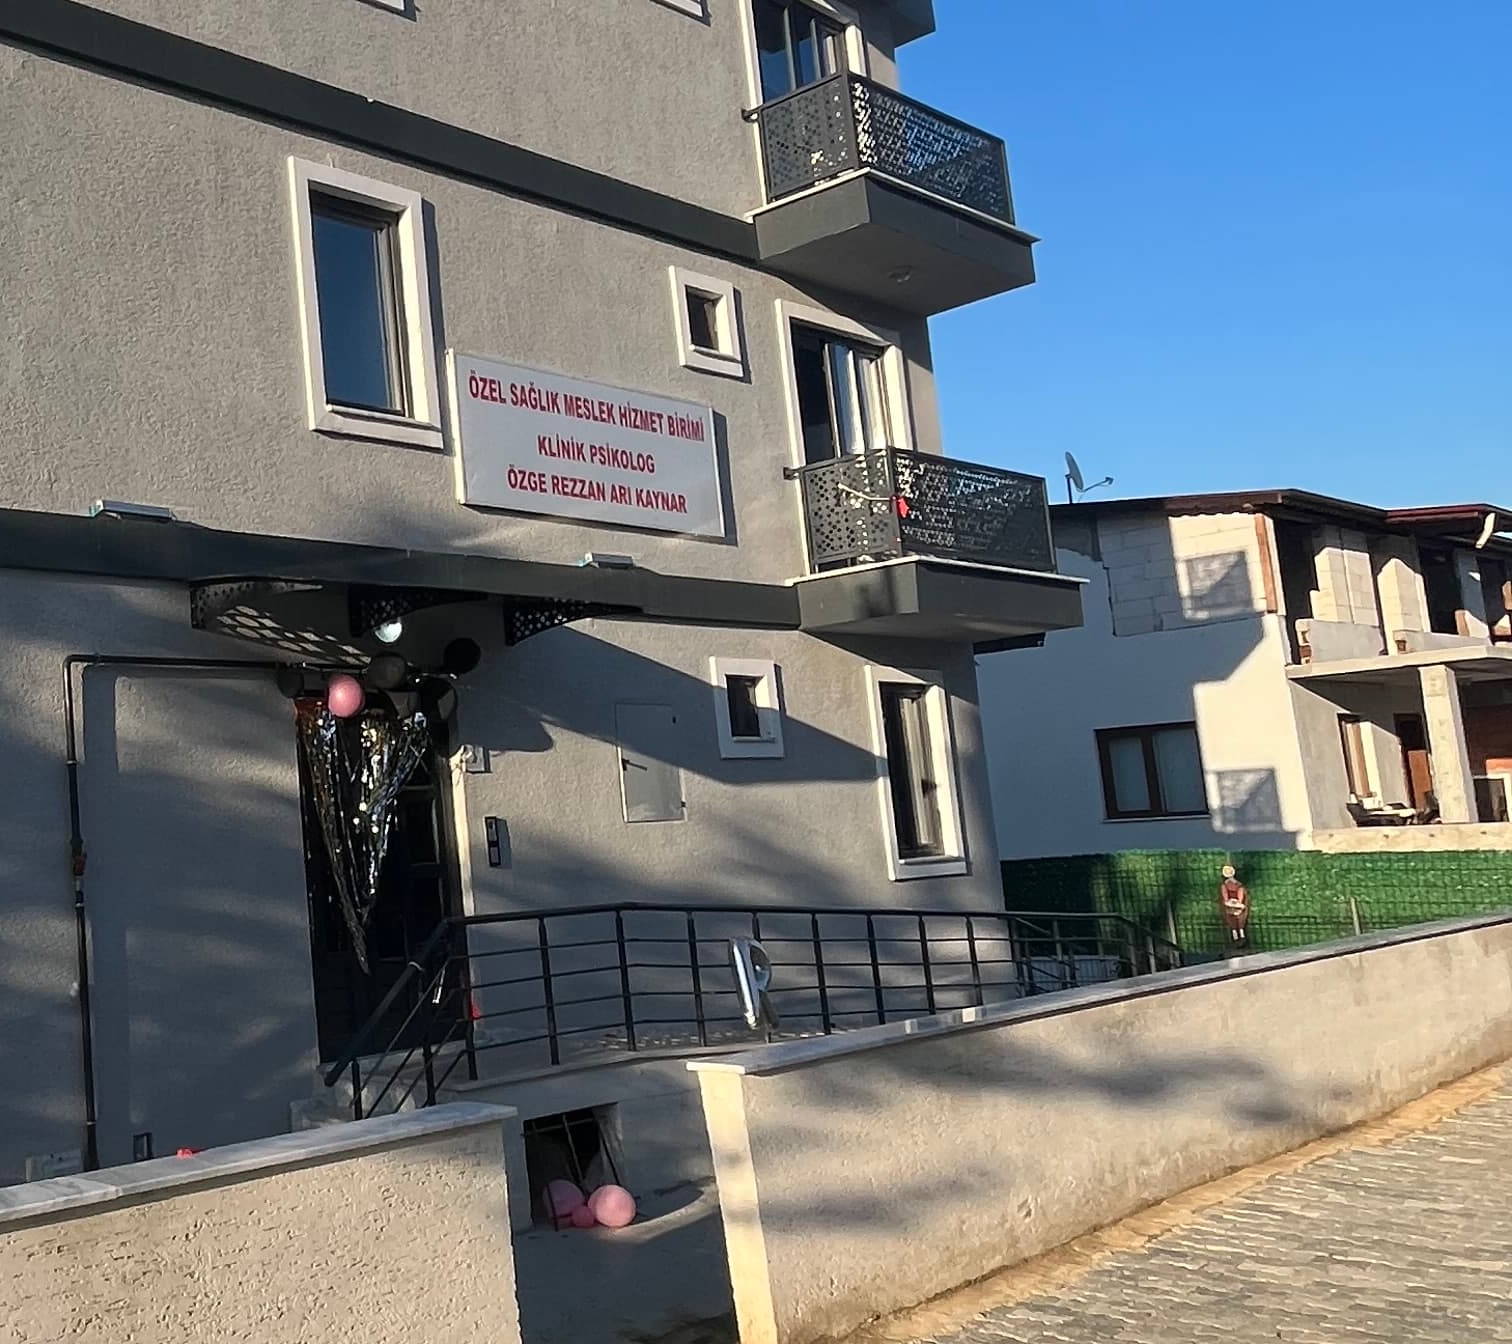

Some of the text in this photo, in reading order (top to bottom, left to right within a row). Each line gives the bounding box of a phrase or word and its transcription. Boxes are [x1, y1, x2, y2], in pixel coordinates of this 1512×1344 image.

[469, 369, 705, 442] ÖZEL SAĞLIK MESLEK HİZMET BİRİMİ
[538, 433, 656, 474] KLİNİK PSİKOLOG
[507, 463, 688, 514] ÖZGE REZZAN ARI KAYNAR
